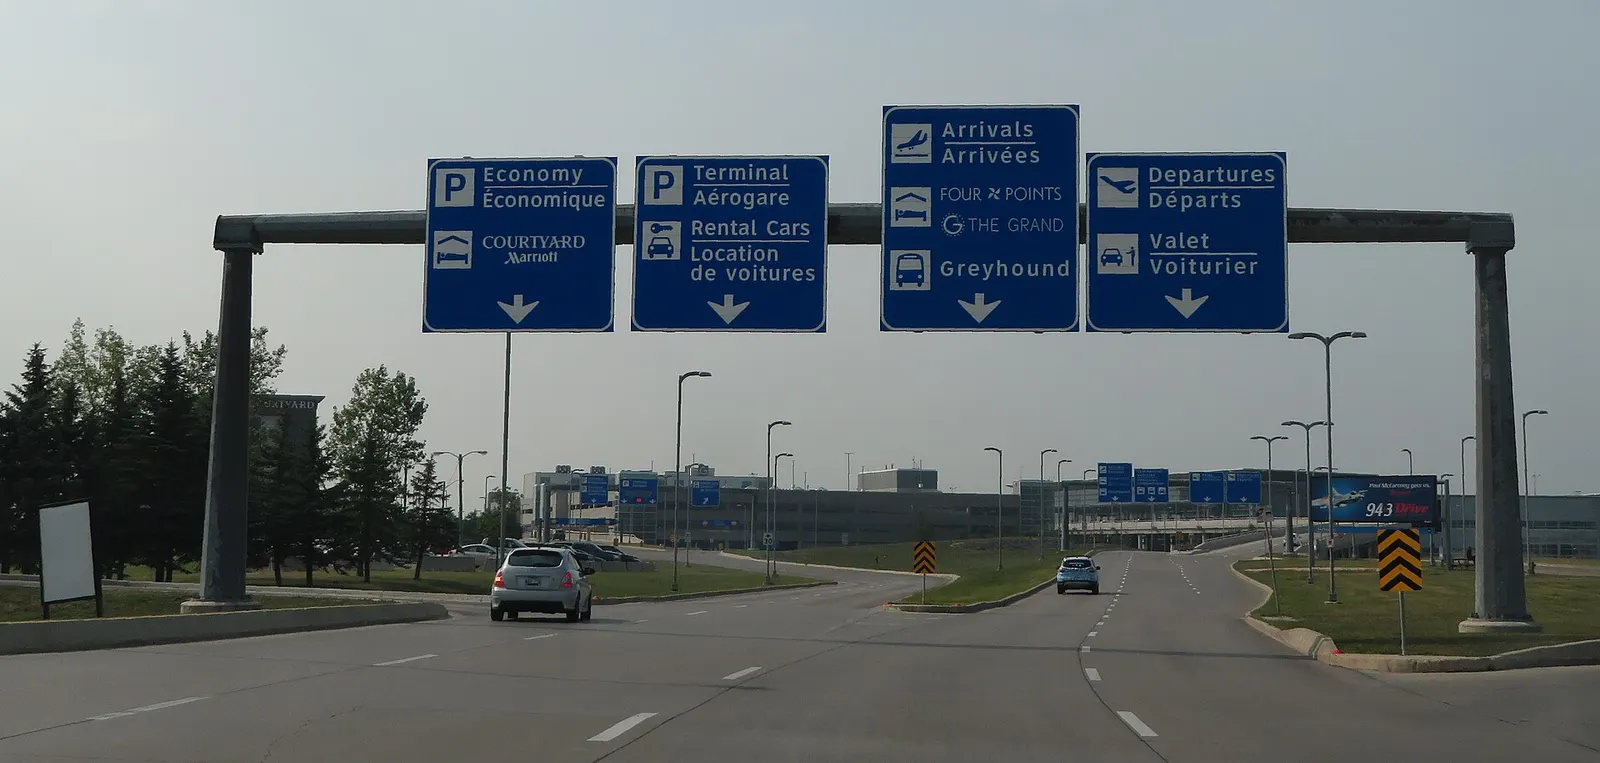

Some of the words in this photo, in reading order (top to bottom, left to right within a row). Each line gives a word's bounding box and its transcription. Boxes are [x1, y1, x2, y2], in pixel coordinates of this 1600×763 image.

[941, 120, 1034, 138] Arrivals
[941, 145, 1040, 164] Arrivées
[483, 166, 585, 187] Economy
[693, 163, 790, 181] Terminal
[1149, 166, 1275, 186] Departures
[445, 173, 466, 202] P
[653, 170, 675, 200] P
[483, 188, 607, 212] Économique
[693, 186, 790, 210] Aérogare
[940, 187, 982, 202] FOUR
[1005, 187, 1062, 202] POINTS
[1149, 190, 1241, 213] Départs
[691, 219, 757, 236] Rental
[766, 219, 810, 236] Cars
[968, 217, 1000, 233] THE
[1007, 217, 1064, 233] GRAND
[482, 235, 586, 249] COURTYARD
[1149, 232, 1210, 249] Valet
[504, 251, 558, 265] Marriott
[691, 244, 779, 262] Location
[690, 264, 716, 282] de
[726, 264, 816, 282] voitures
[940, 259, 1070, 281] Greyhound
[1149, 257, 1258, 275] Voiturier
